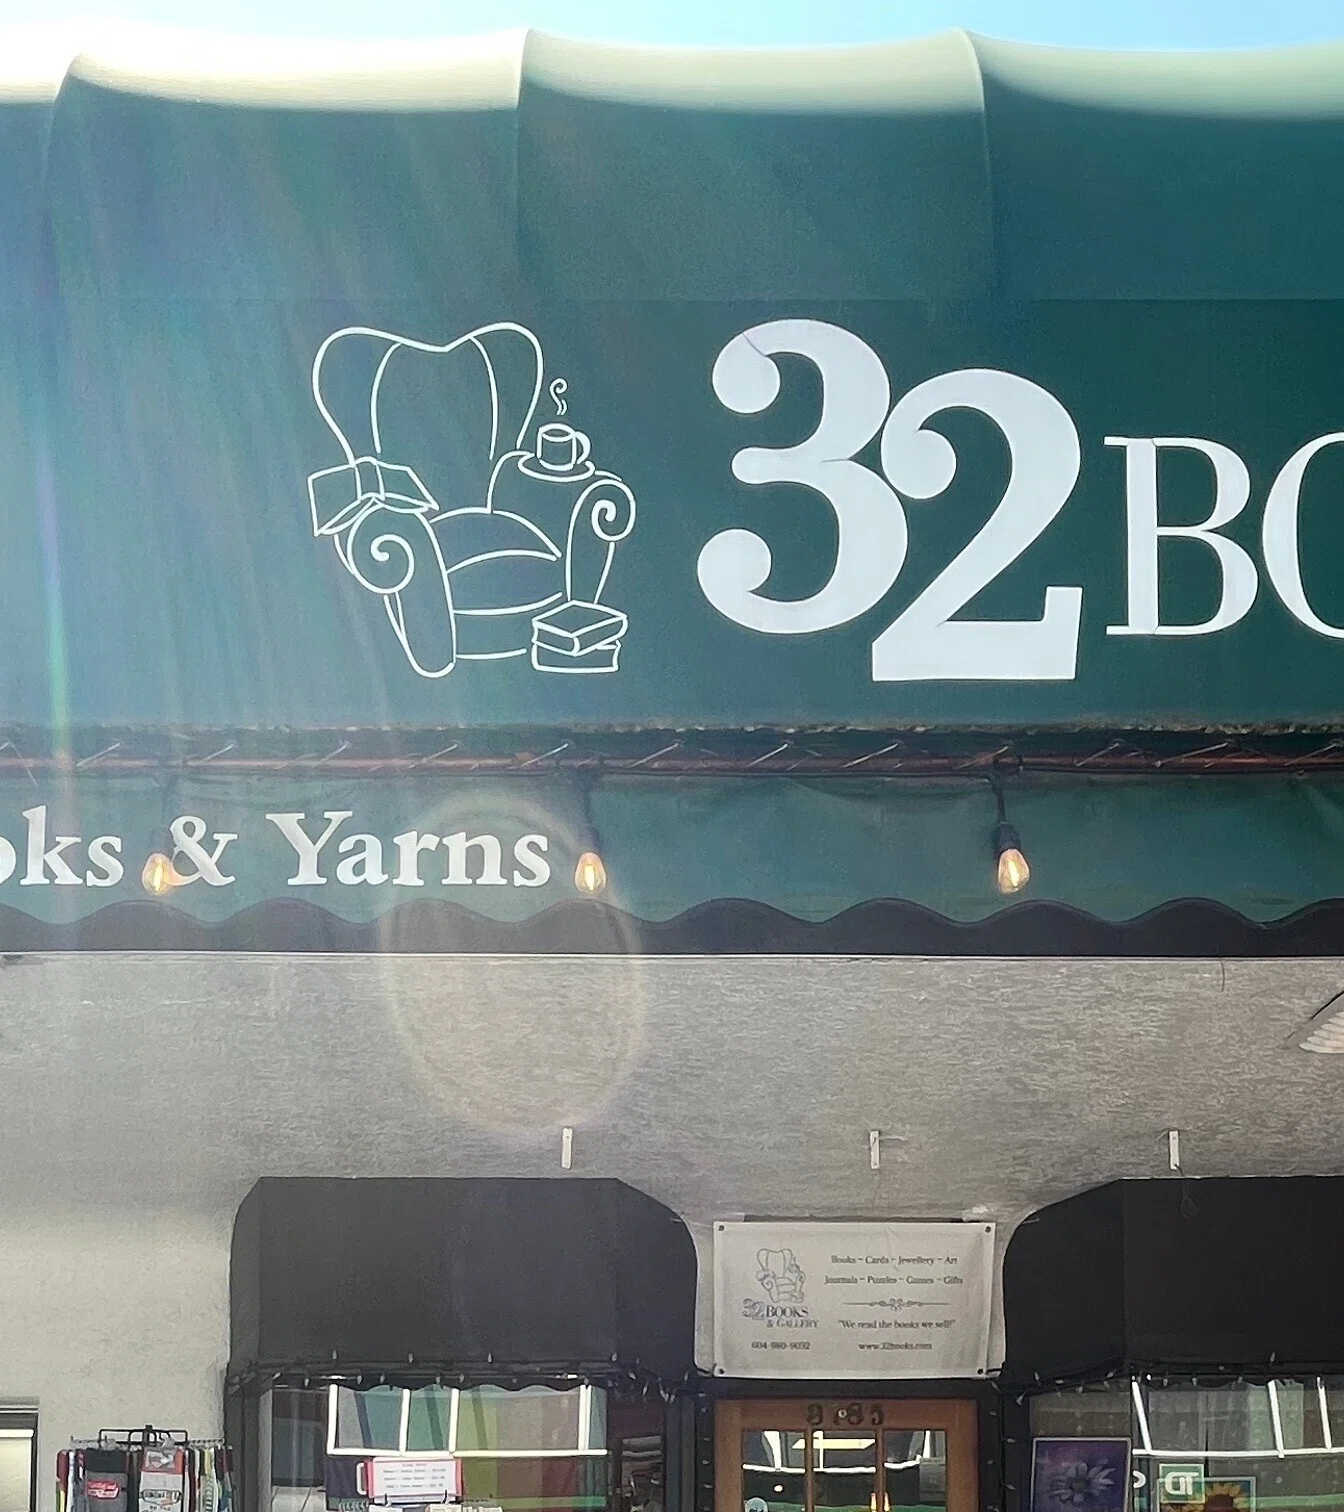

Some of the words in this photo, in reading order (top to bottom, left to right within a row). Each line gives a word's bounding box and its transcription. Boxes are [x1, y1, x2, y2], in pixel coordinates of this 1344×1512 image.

[696, 318, 1083, 682] 32
[166, 815, 236, 888] &
[266, 809, 553, 888] Yarns
[831, 1255, 856, 1264] Books
[865, 1255, 889, 1264] Cards
[944, 1256, 958, 1265] Art
[742, 1298, 765, 1320] 32
[766, 1304, 809, 1318] BOOKS
